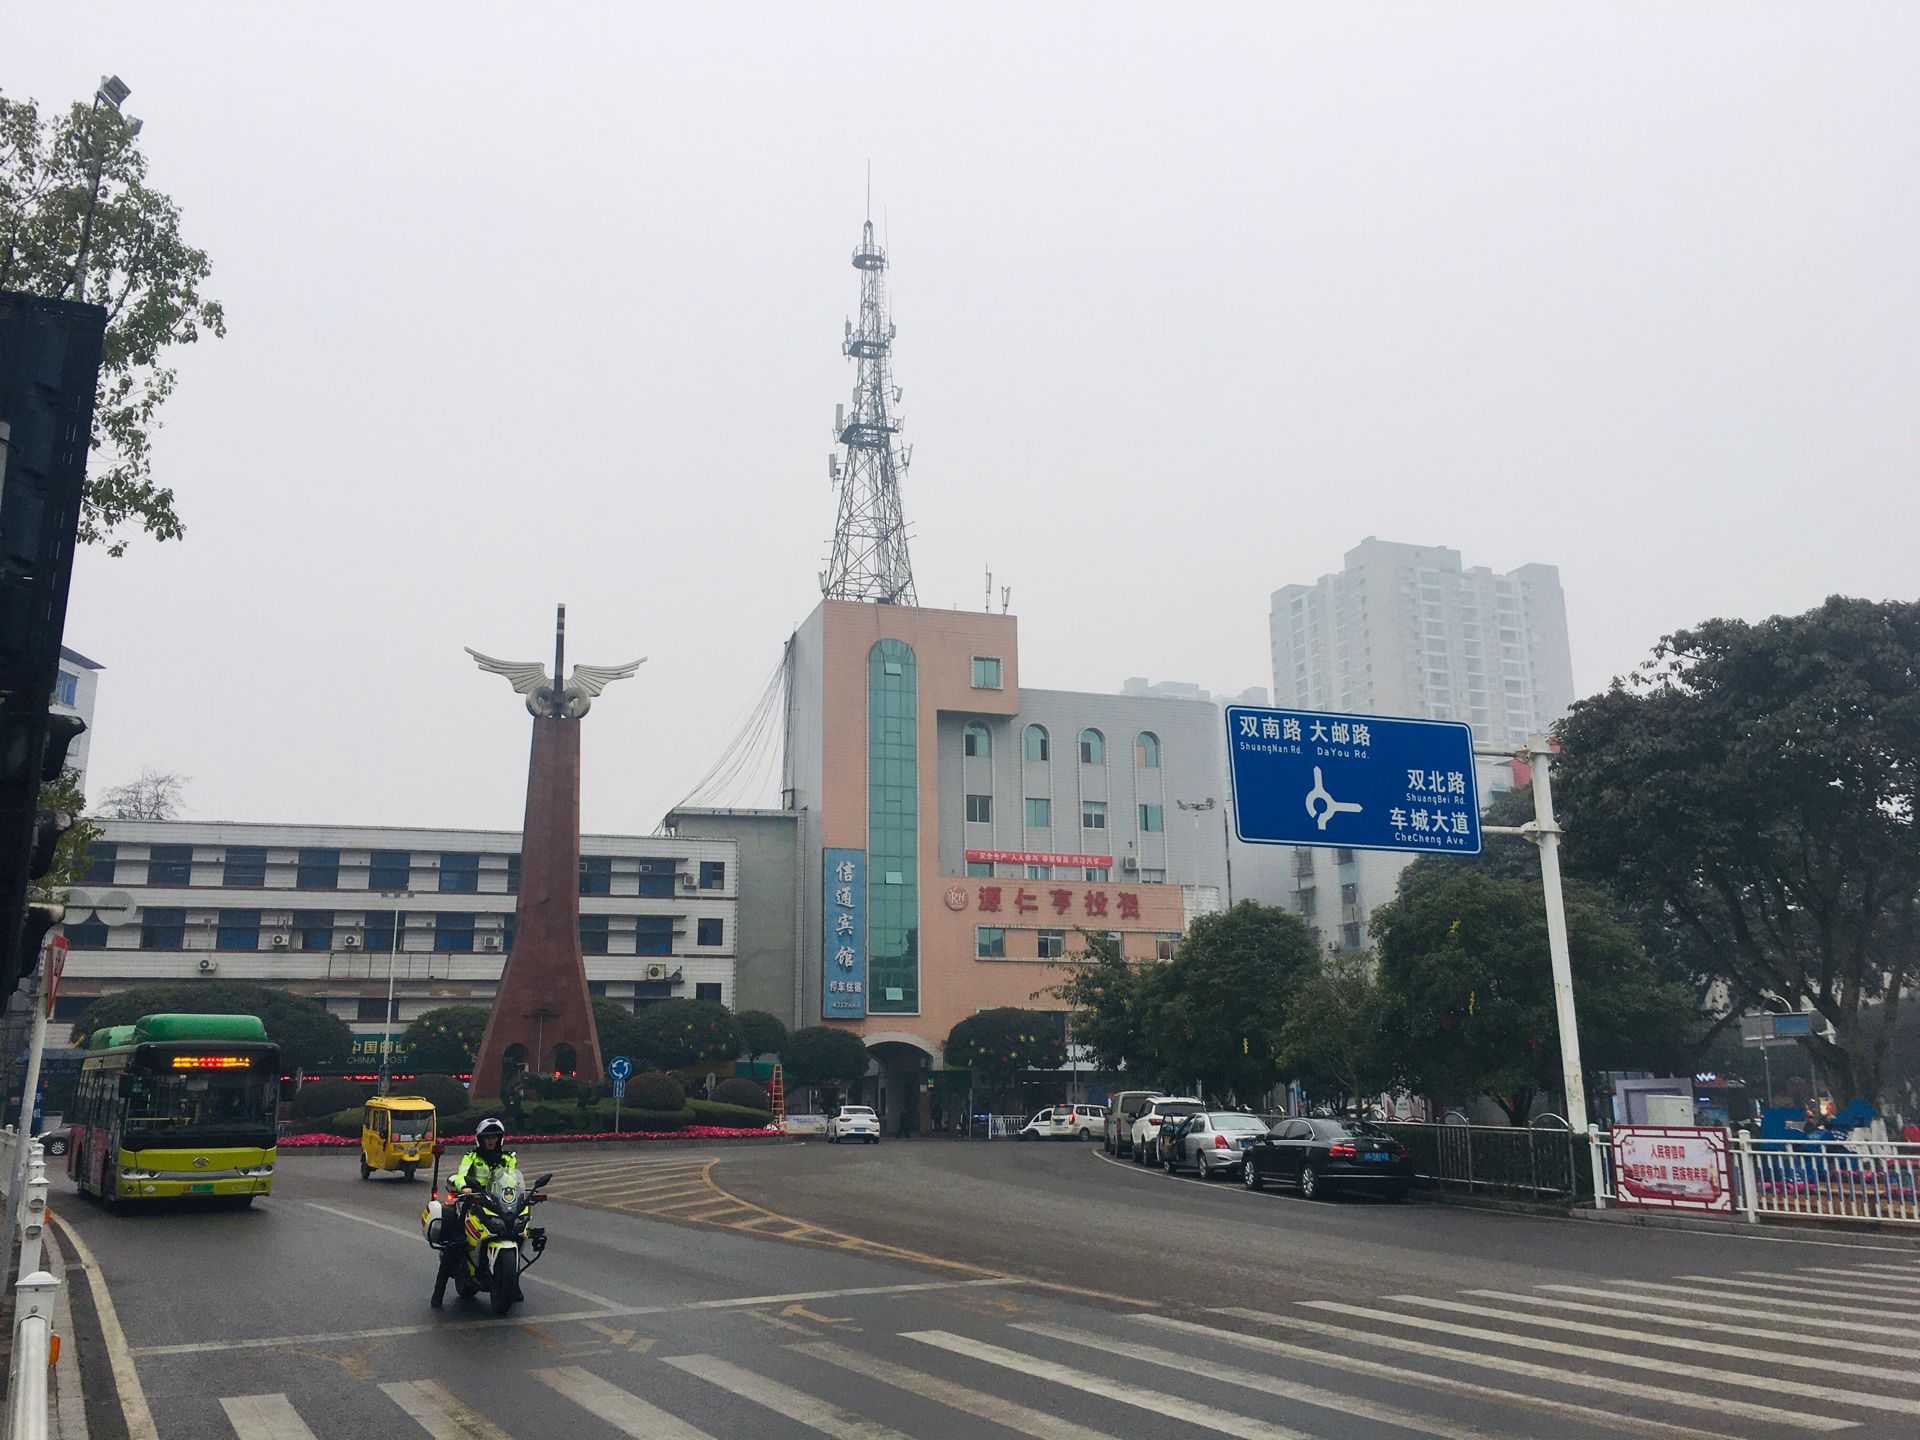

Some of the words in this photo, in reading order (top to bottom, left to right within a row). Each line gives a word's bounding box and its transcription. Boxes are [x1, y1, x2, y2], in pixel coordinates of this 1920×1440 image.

[1239, 715, 1301, 742] 双南路
[1309, 720, 1371, 747] 大邮路
[1240, 741, 1288, 755] ShuangNan
[1291, 745, 1304, 755] Rd.
[1317, 747, 1350, 758] DaYou
[1354, 751, 1370, 760] Rd.
[1407, 769, 1465, 795] 双北路
[1406, 792, 1450, 805] ShuangBei
[1454, 796, 1467, 805] Rd.
[1389, 807, 1470, 834] 车城大道
[1395, 832, 1442, 846] CheCheng
[1446, 836, 1468, 845] Ave.
[979, 852, 1007, 861] 安全生产
[1011, 854, 1039, 863] 人人参与
[978, 886, 1141, 920] 源仁亨投资
[835, 861, 856, 968] 信通宾馆
[830, 981, 862, 993] 停车住宿
[346, 1056, 376, 1065] CHINA
[1650, 1143, 1686, 1159] 人民有信仰
[1632, 1163, 1667, 1180] 国家有力量
[1672, 1165, 1709, 1182] 民族有希望
